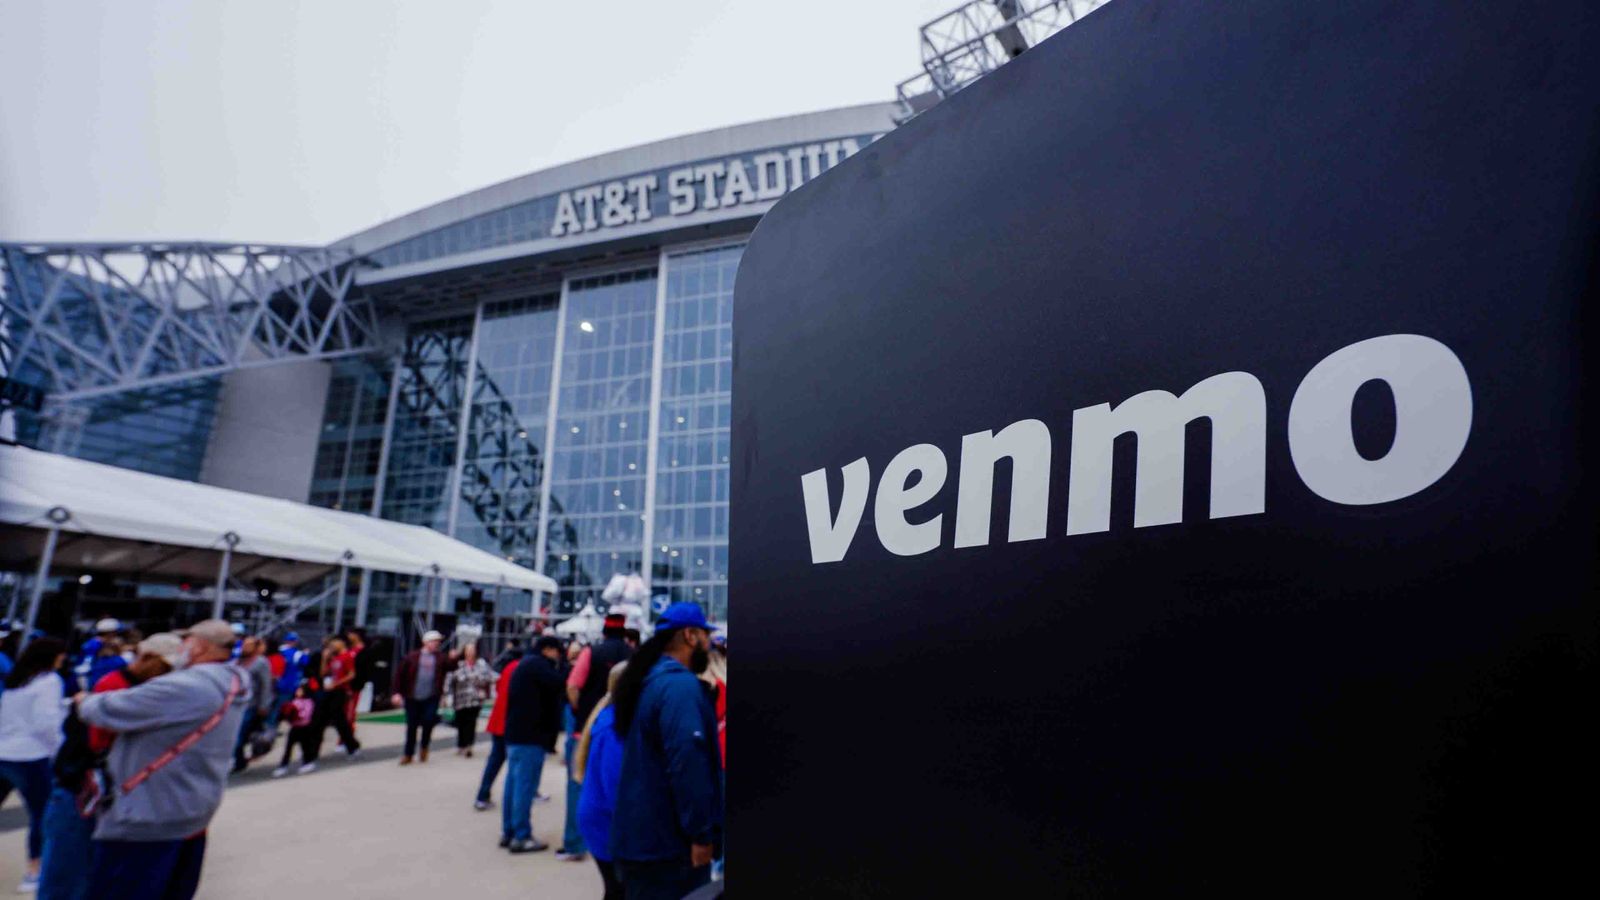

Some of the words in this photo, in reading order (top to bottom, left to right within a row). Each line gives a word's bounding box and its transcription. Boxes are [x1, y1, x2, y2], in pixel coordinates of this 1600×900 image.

[551, 175, 657, 237] AT&T
[668, 133, 886, 216] STADIU
[801, 334, 1473, 564] venmo
